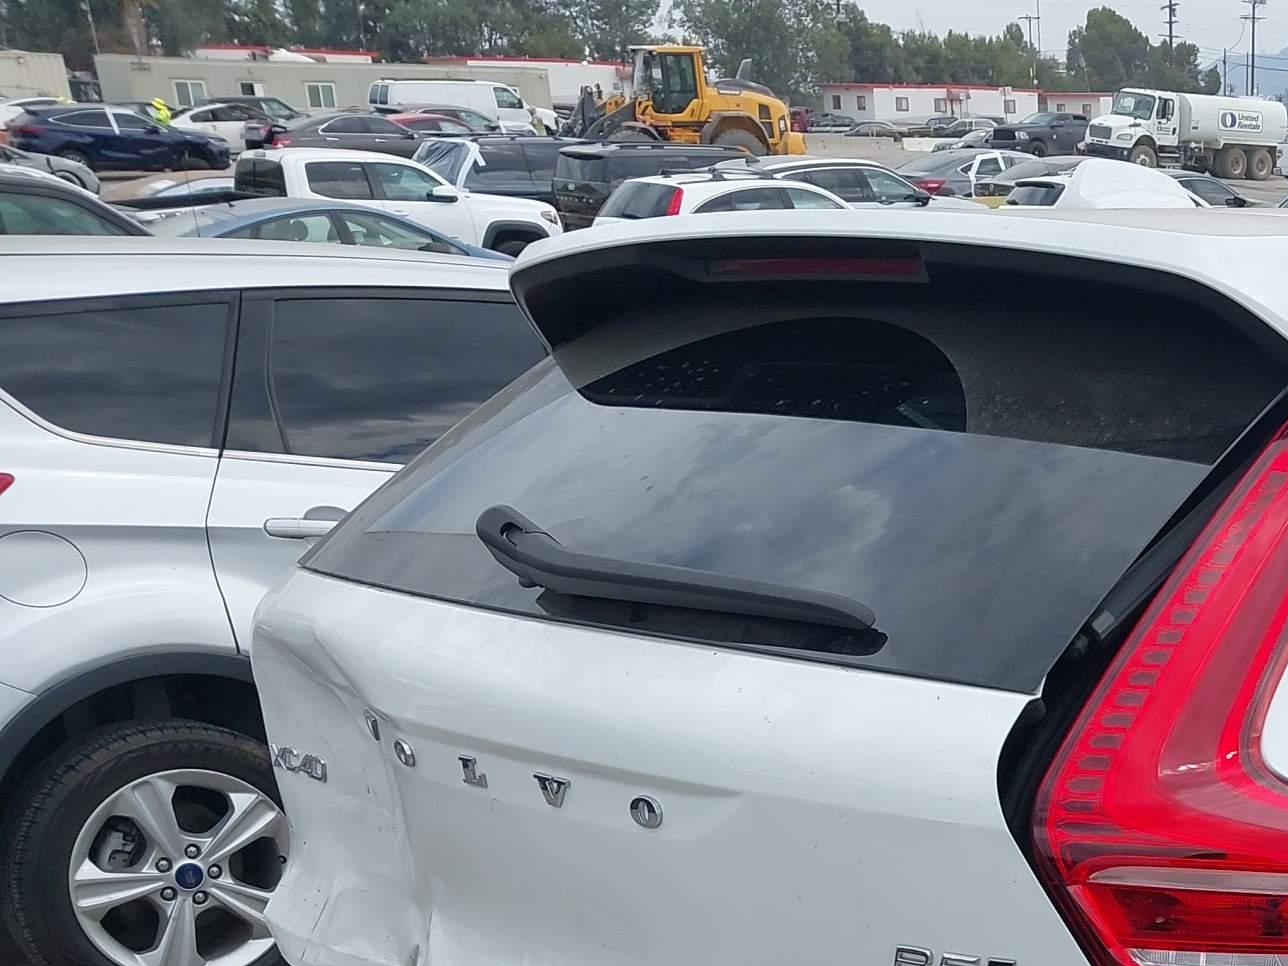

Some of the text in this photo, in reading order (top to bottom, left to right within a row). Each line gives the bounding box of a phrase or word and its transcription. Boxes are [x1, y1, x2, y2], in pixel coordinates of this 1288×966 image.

[1238, 113, 1259, 122] United
[1237, 121, 1260, 130] Rentals
[271, 743, 328, 784] XC40
